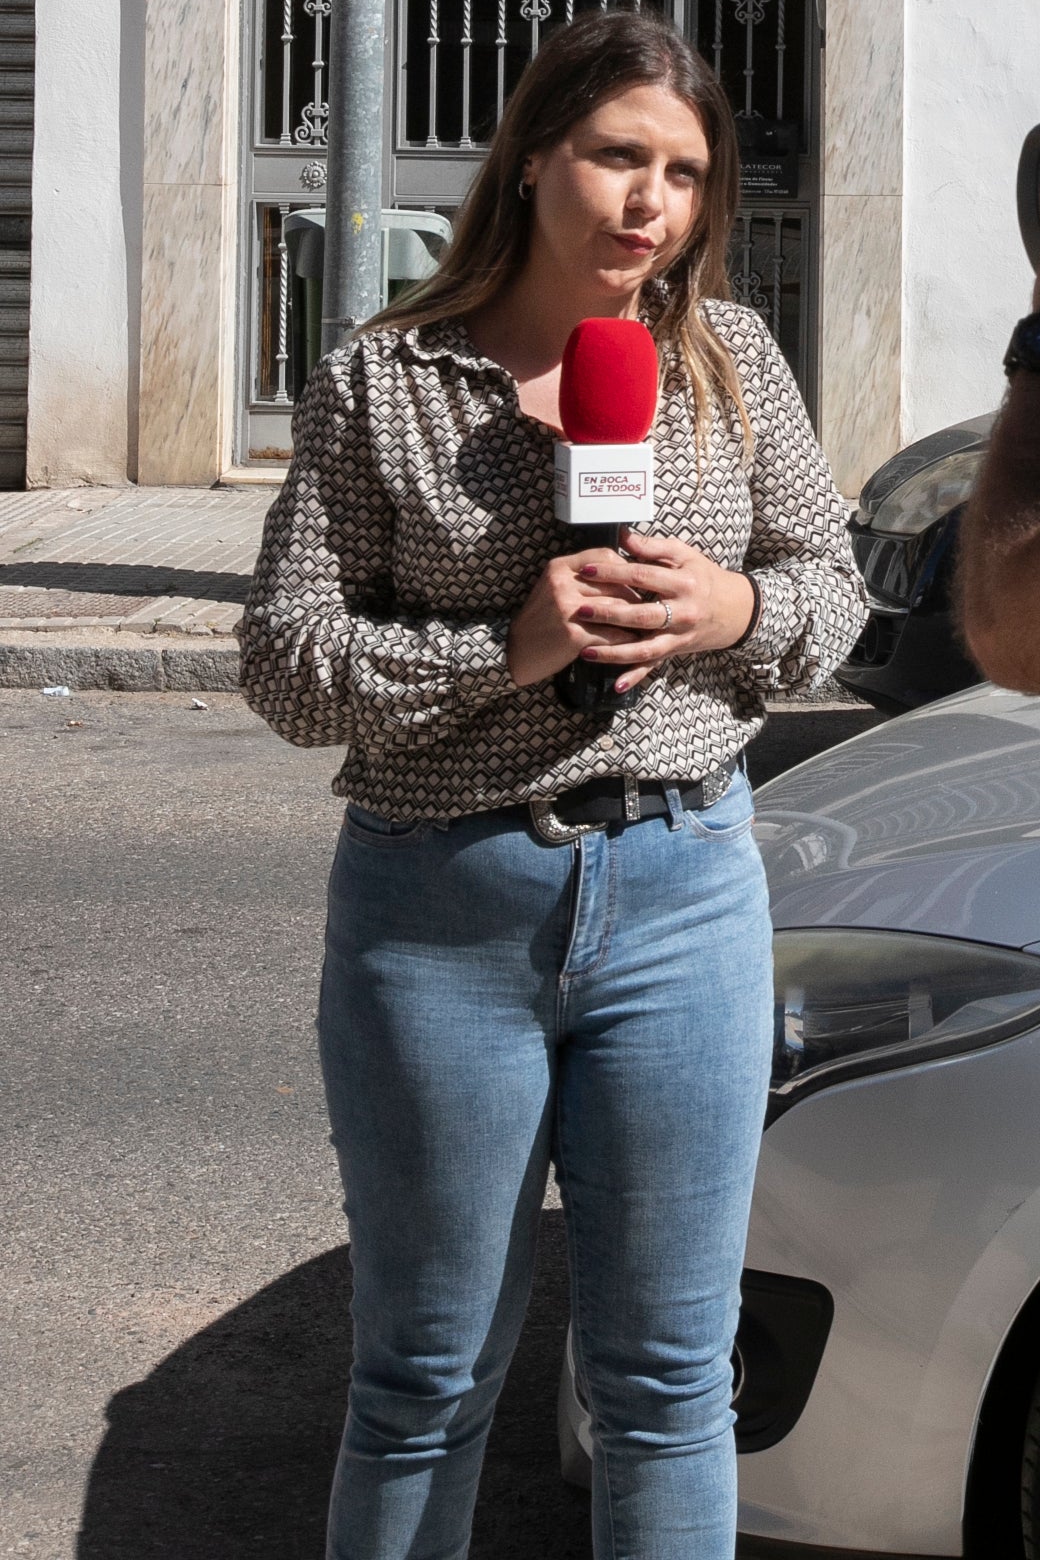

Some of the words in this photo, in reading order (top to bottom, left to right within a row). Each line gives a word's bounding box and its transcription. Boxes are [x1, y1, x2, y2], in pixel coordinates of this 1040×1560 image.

[583, 476, 598, 485] EN
[600, 475, 629, 485] BOCA
[589, 484, 604, 493] DE
[606, 483, 642, 493] TODOS
